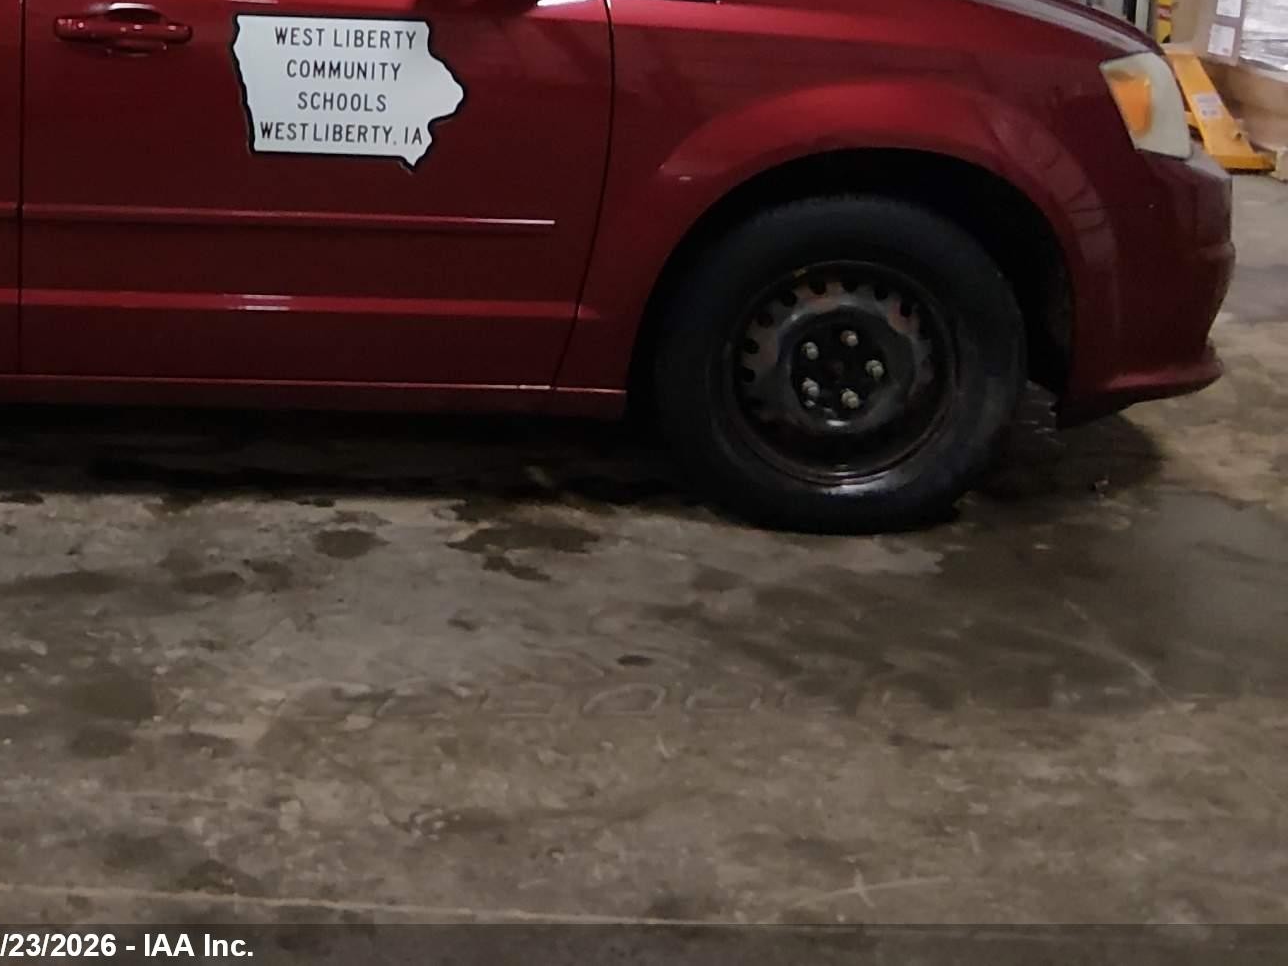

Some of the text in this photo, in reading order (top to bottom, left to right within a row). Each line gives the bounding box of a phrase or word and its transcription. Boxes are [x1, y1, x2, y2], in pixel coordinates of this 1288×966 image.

[274, 26, 417, 50] WEST LIBERTY
[286, 59, 402, 81] COMMUNITY
[297, 91, 387, 112] SCHOOLS
[404, 126, 423, 145] IA
